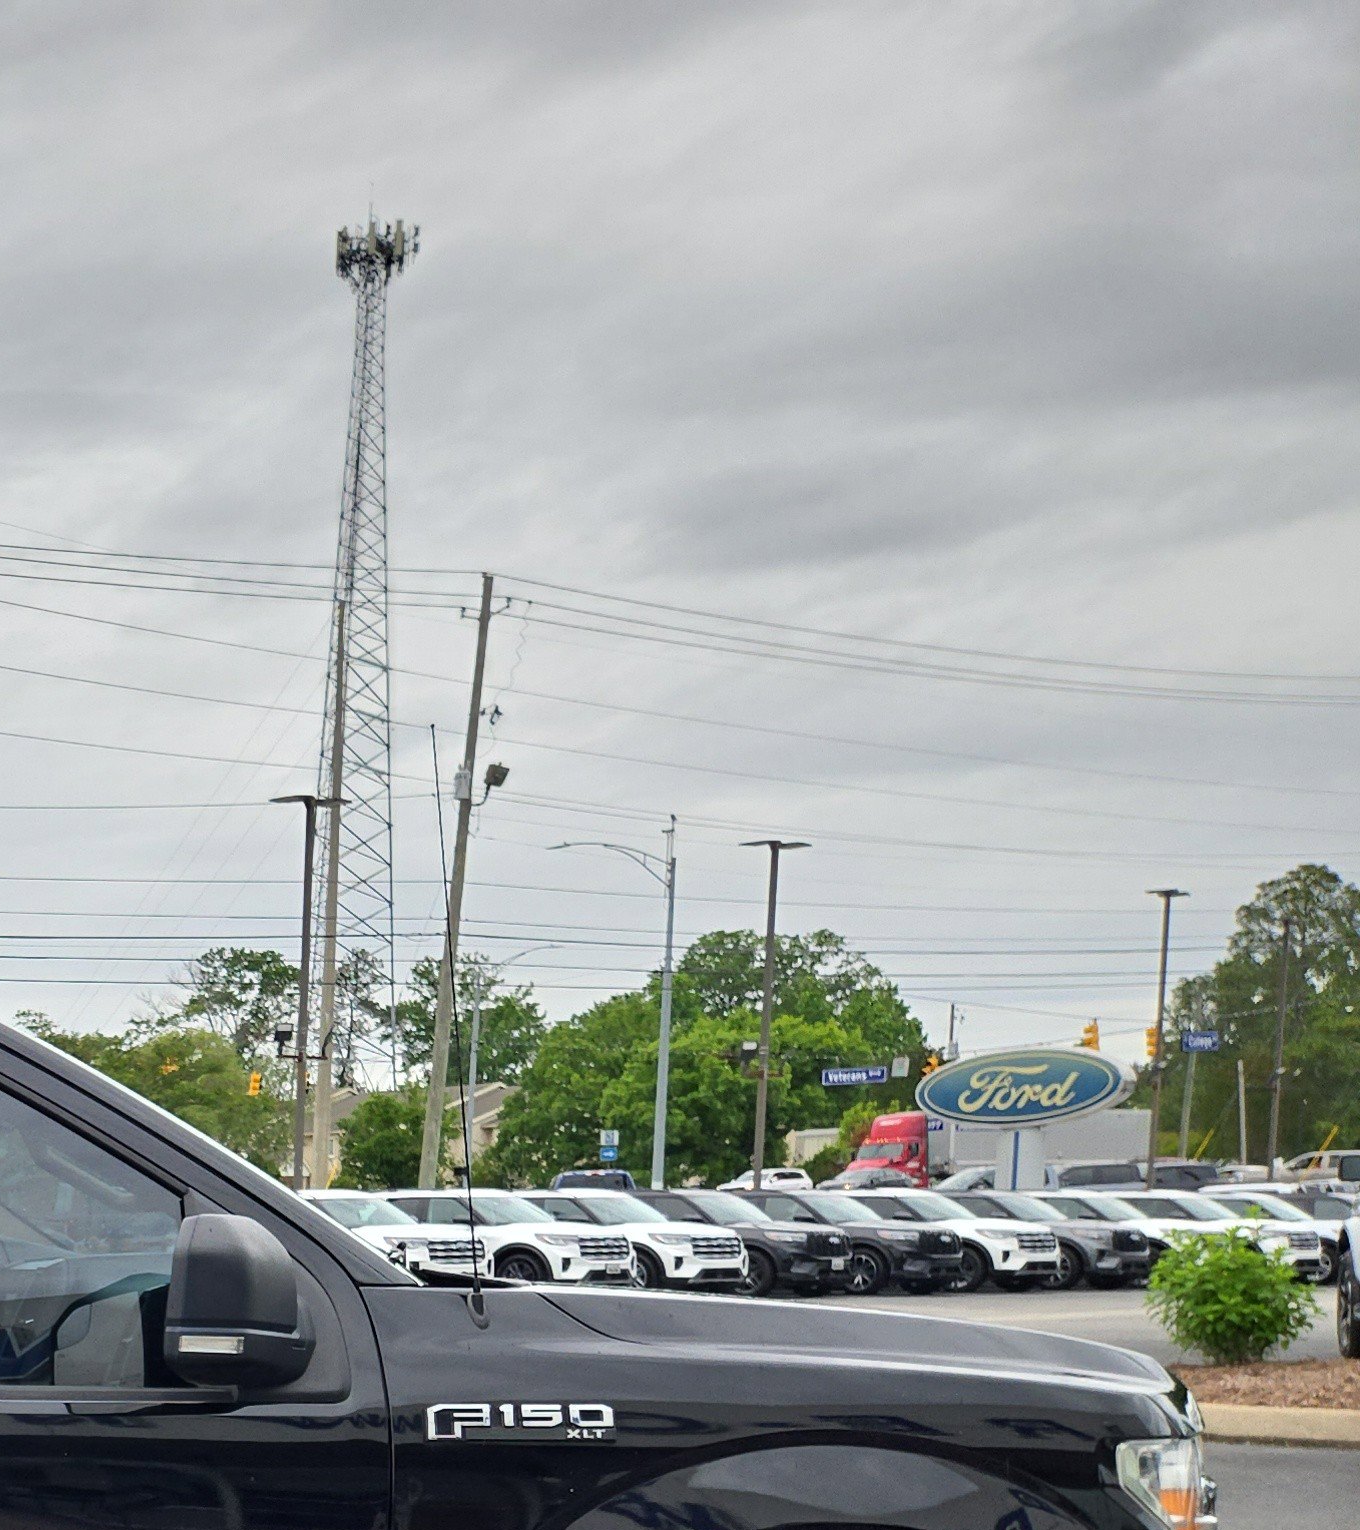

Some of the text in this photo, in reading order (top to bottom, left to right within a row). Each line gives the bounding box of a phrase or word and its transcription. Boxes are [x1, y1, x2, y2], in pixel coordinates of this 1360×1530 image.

[827, 1070, 868, 1083] Veterans
[957, 1063, 1080, 1113] Ford
[566, 1428, 607, 1439] XLT
